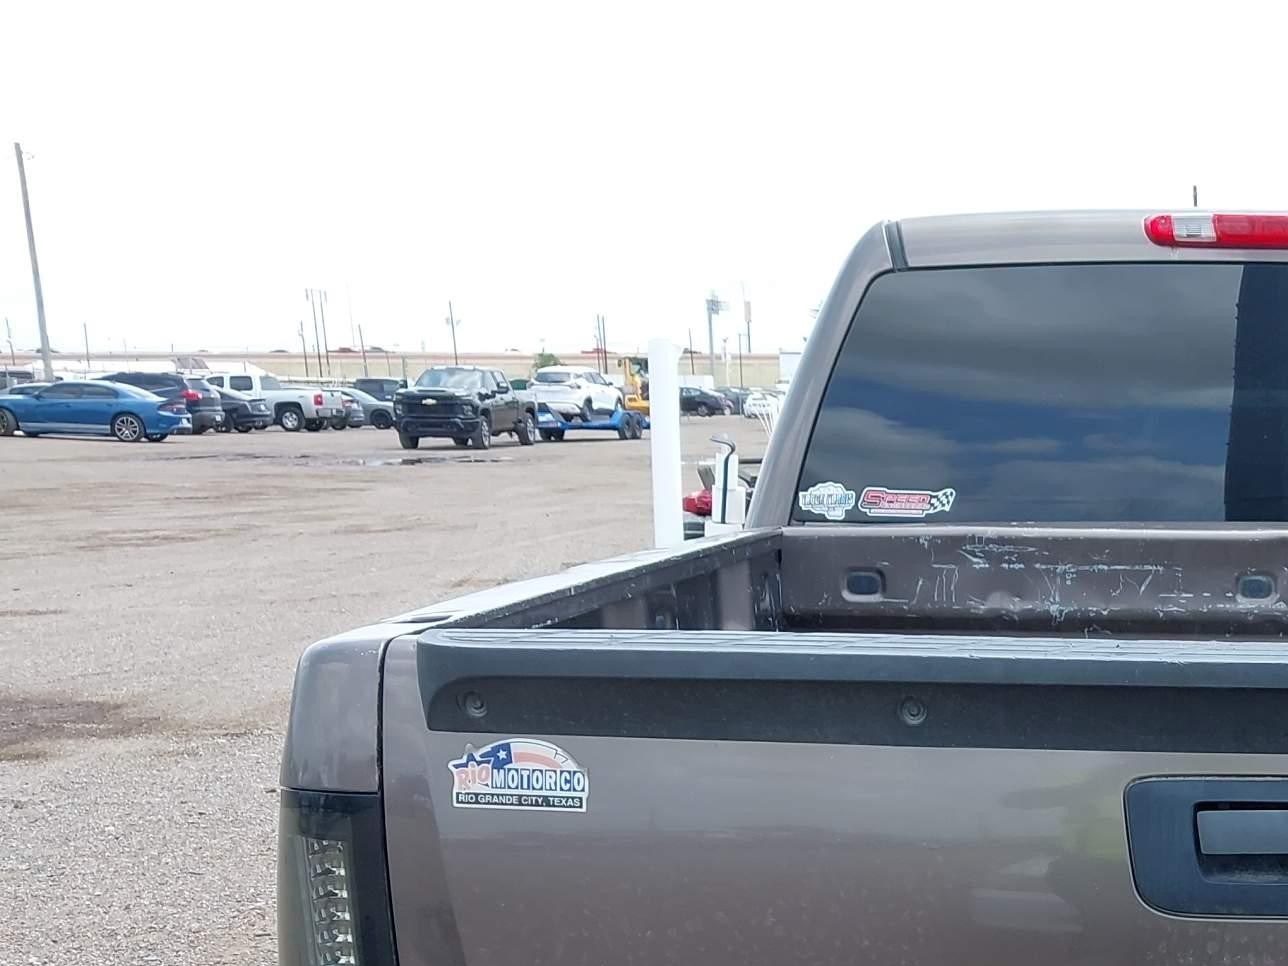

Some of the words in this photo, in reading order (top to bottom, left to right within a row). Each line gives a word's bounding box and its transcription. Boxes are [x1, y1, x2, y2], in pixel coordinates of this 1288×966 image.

[458, 794, 475, 803] RIO
[478, 794, 519, 804] GRANDE
[521, 796, 546, 806] CITY,
[549, 797, 580, 807] TEXAS
